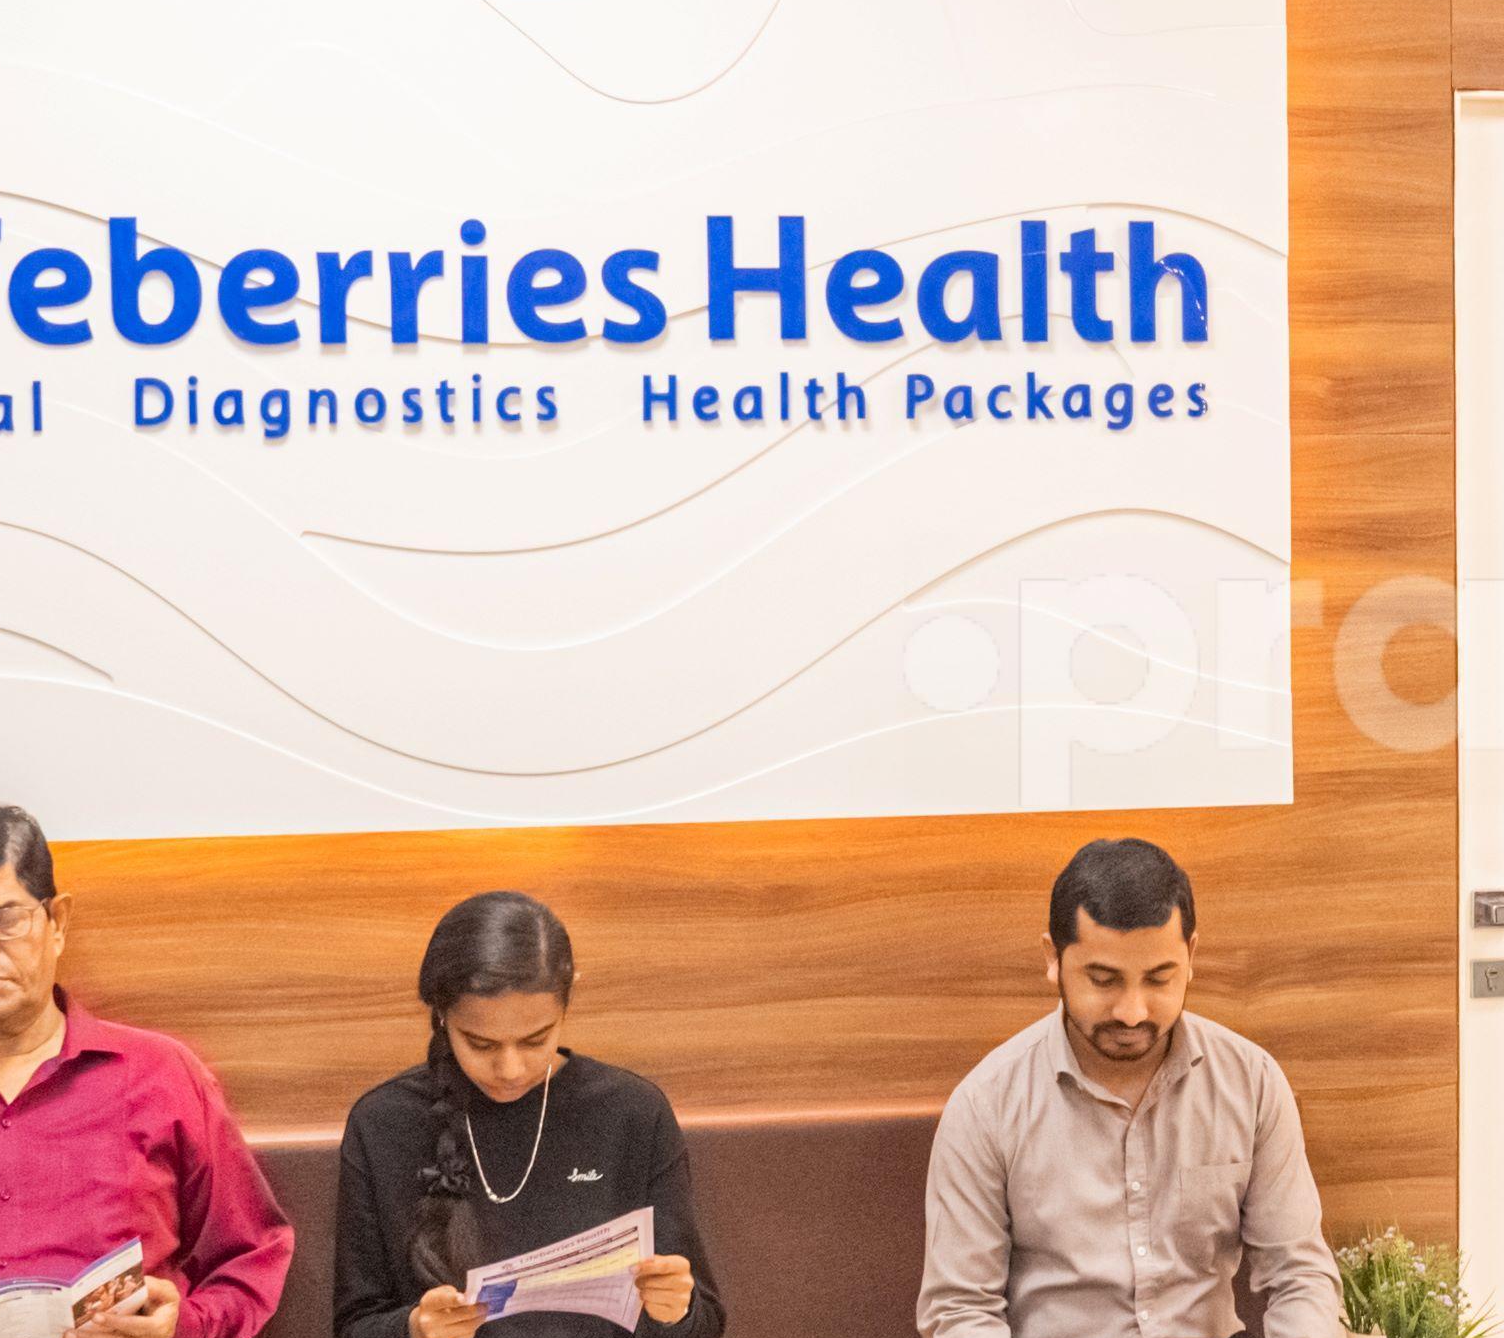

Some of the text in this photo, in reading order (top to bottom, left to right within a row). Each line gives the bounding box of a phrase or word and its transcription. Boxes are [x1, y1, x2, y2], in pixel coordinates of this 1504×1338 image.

[707, 215, 1208, 343] Health
[134, 374, 557, 439] Diagnostics
[643, 372, 866, 422] Health
[906, 372, 1204, 430] Packages
[567, 1167, 603, 1182] Smile
